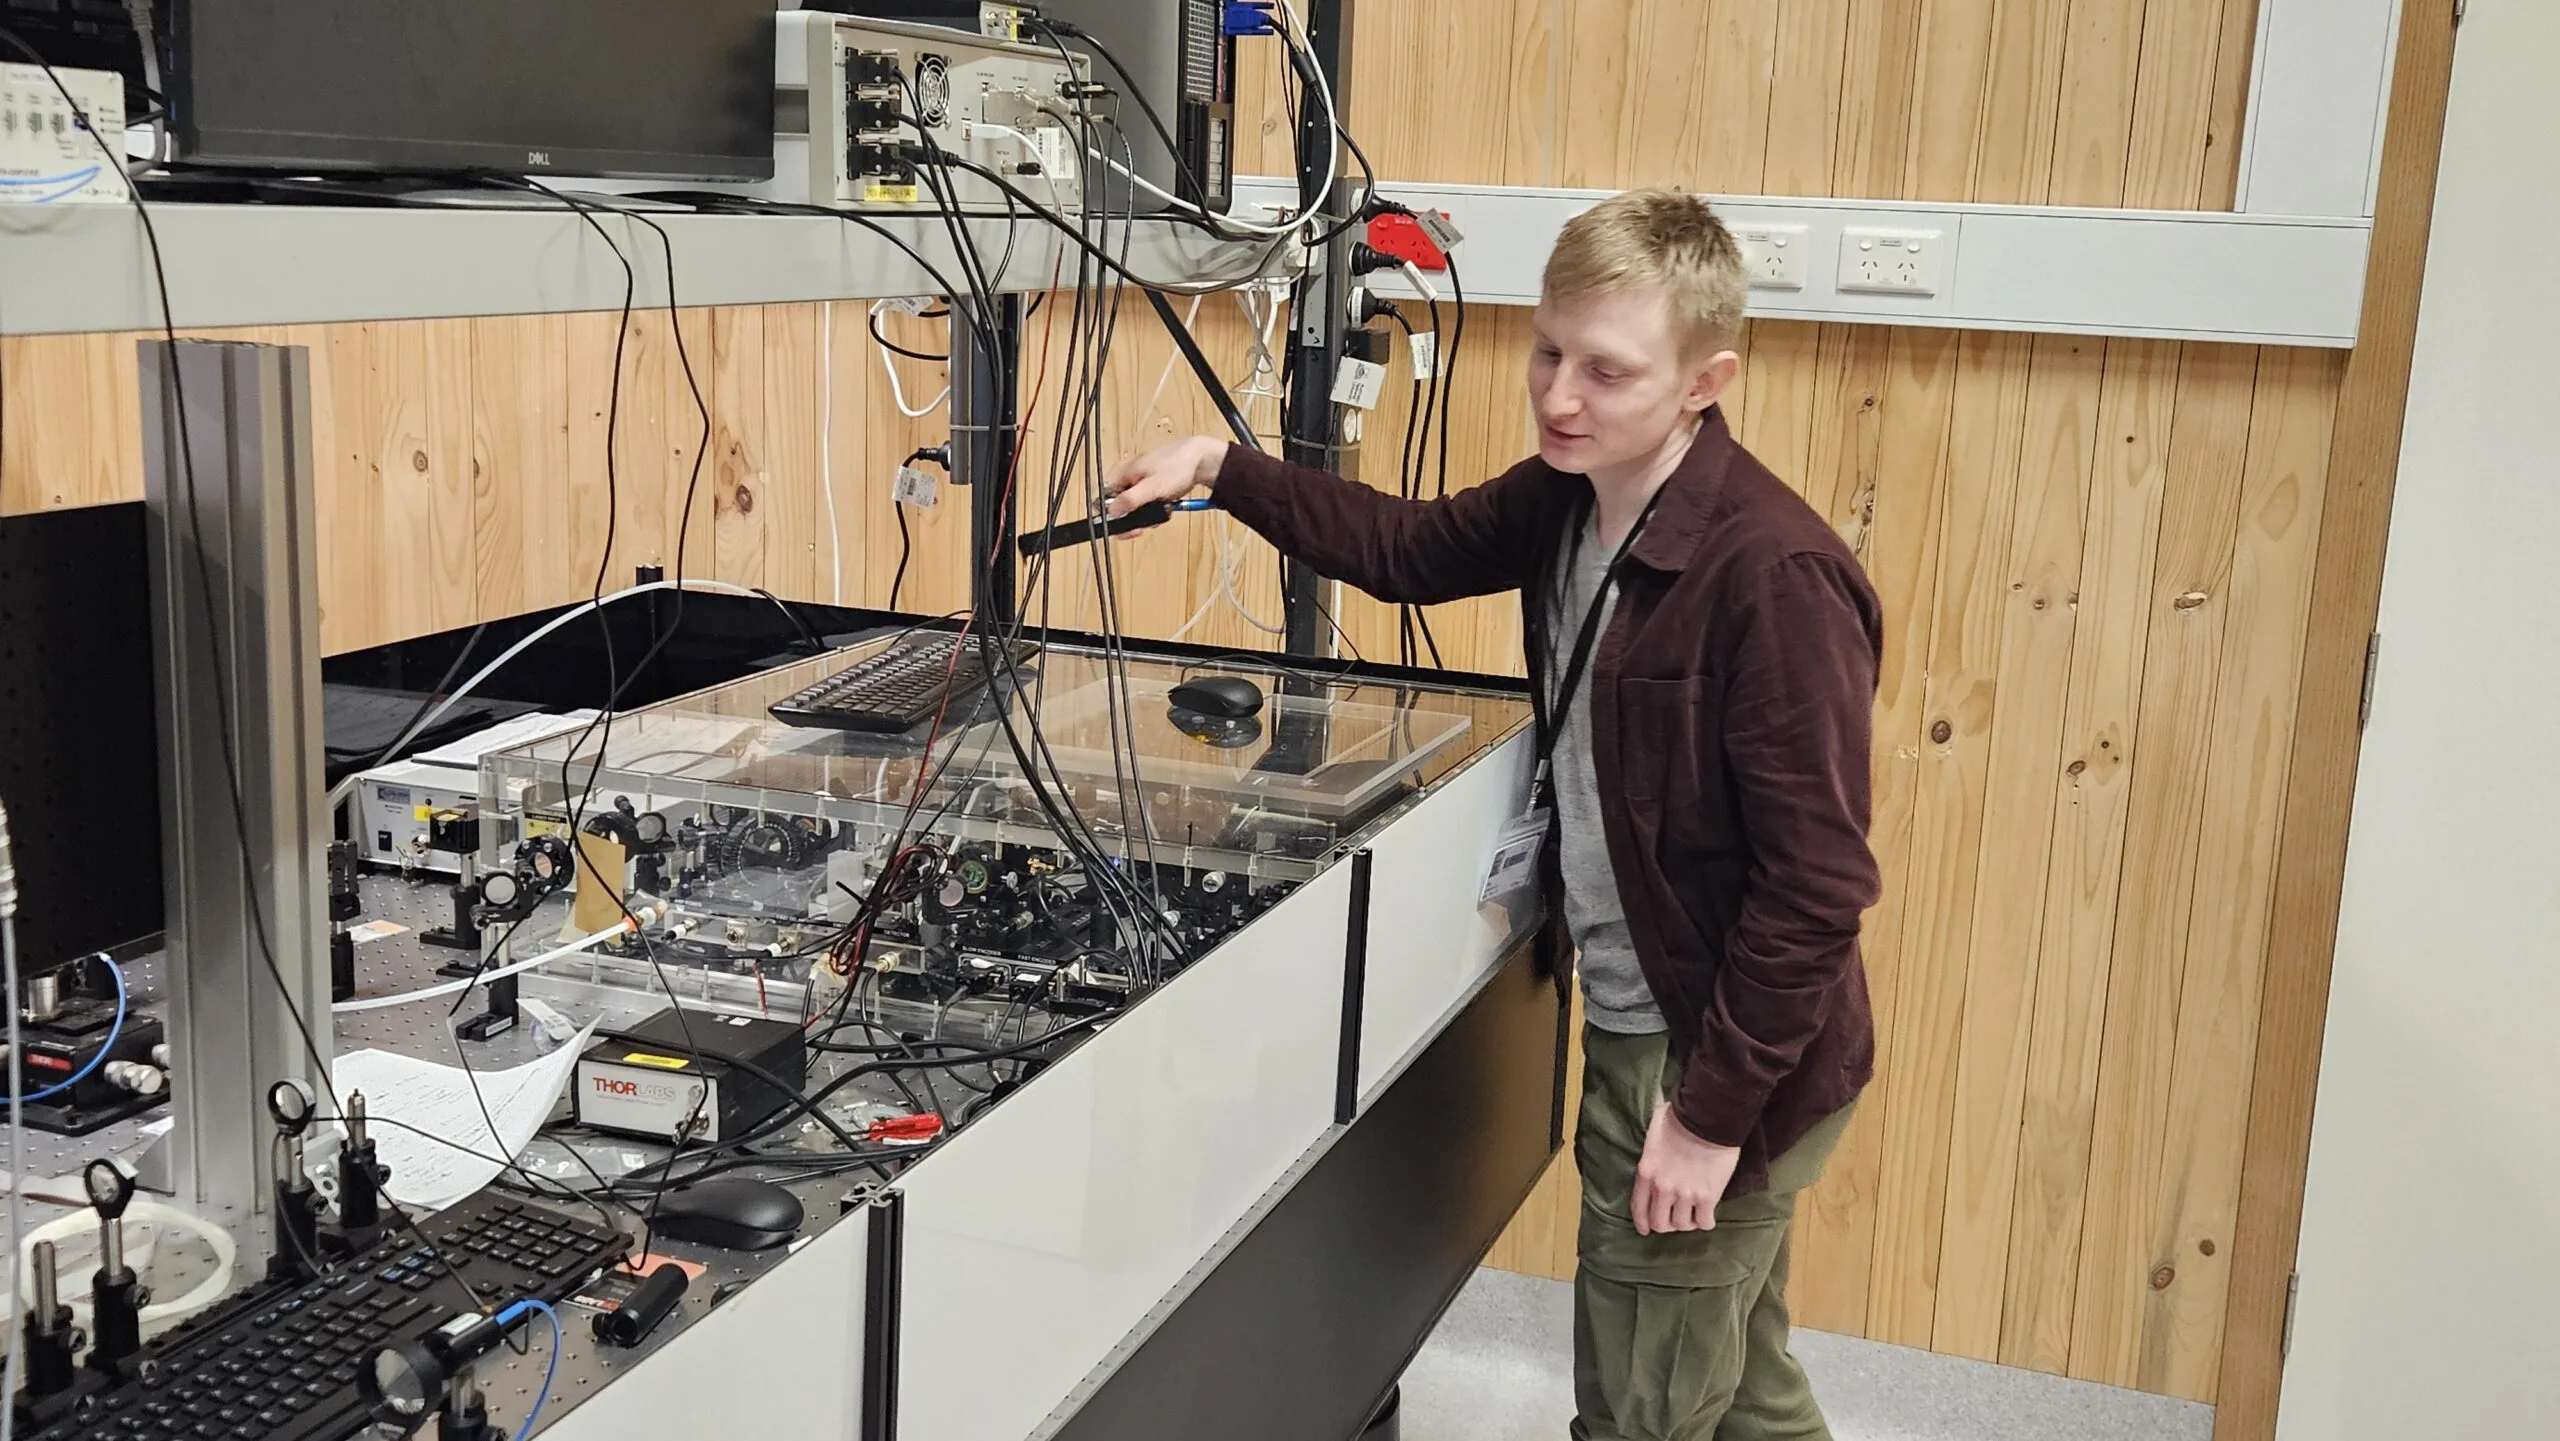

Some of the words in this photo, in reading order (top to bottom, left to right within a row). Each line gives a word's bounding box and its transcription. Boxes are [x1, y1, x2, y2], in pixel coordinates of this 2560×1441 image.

[528, 152, 550, 165] DELL
[1018, 954, 1031, 962] FAST
[593, 1077, 675, 1100] THORLABS
